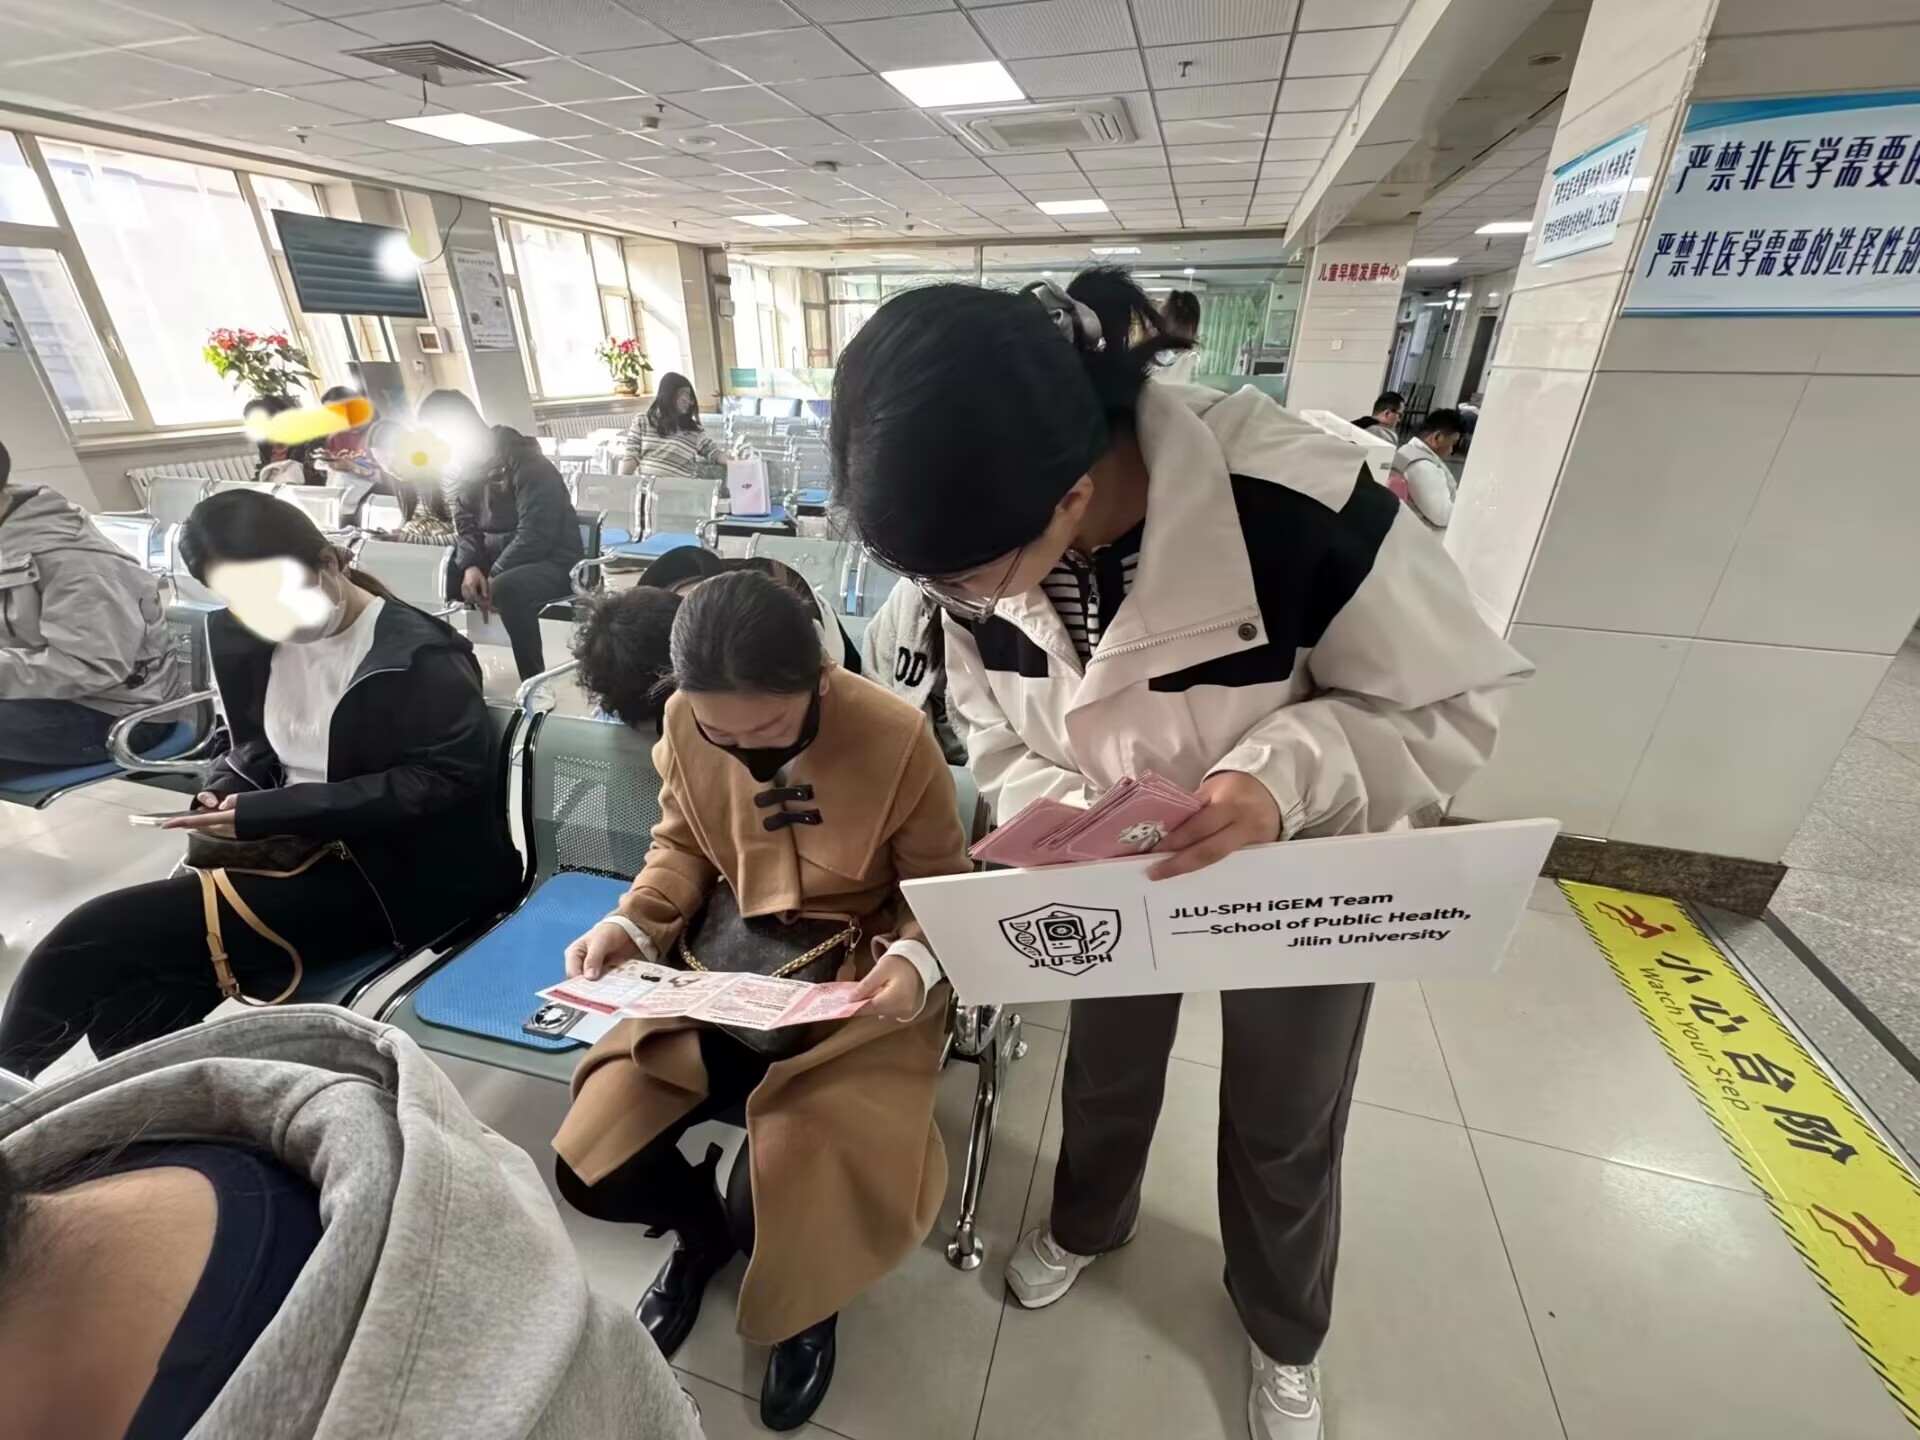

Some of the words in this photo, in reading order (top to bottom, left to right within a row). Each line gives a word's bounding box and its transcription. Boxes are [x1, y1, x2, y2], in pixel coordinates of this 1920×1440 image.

[1318, 262, 1400, 281] 儿童早期发展中心
[1169, 905, 1261, 919] JLU-SPH
[1268, 897, 1323, 912] iGEM
[1329, 894, 1393, 907] Team
[1286, 917, 1310, 929] of
[1314, 913, 1383, 927] Public
[1388, 908, 1471, 922] Health,
[1287, 935, 1332, 948] Jilin
[1338, 929, 1451, 944] University
[1029, 953, 1112, 968] JLU-SPH
[1639, 967, 1685, 1016] Watch
[1677, 1022, 1715, 1062] Your
[1707, 1066, 1750, 1111] Step
[1655, 951, 1859, 1166] 小心台阶
